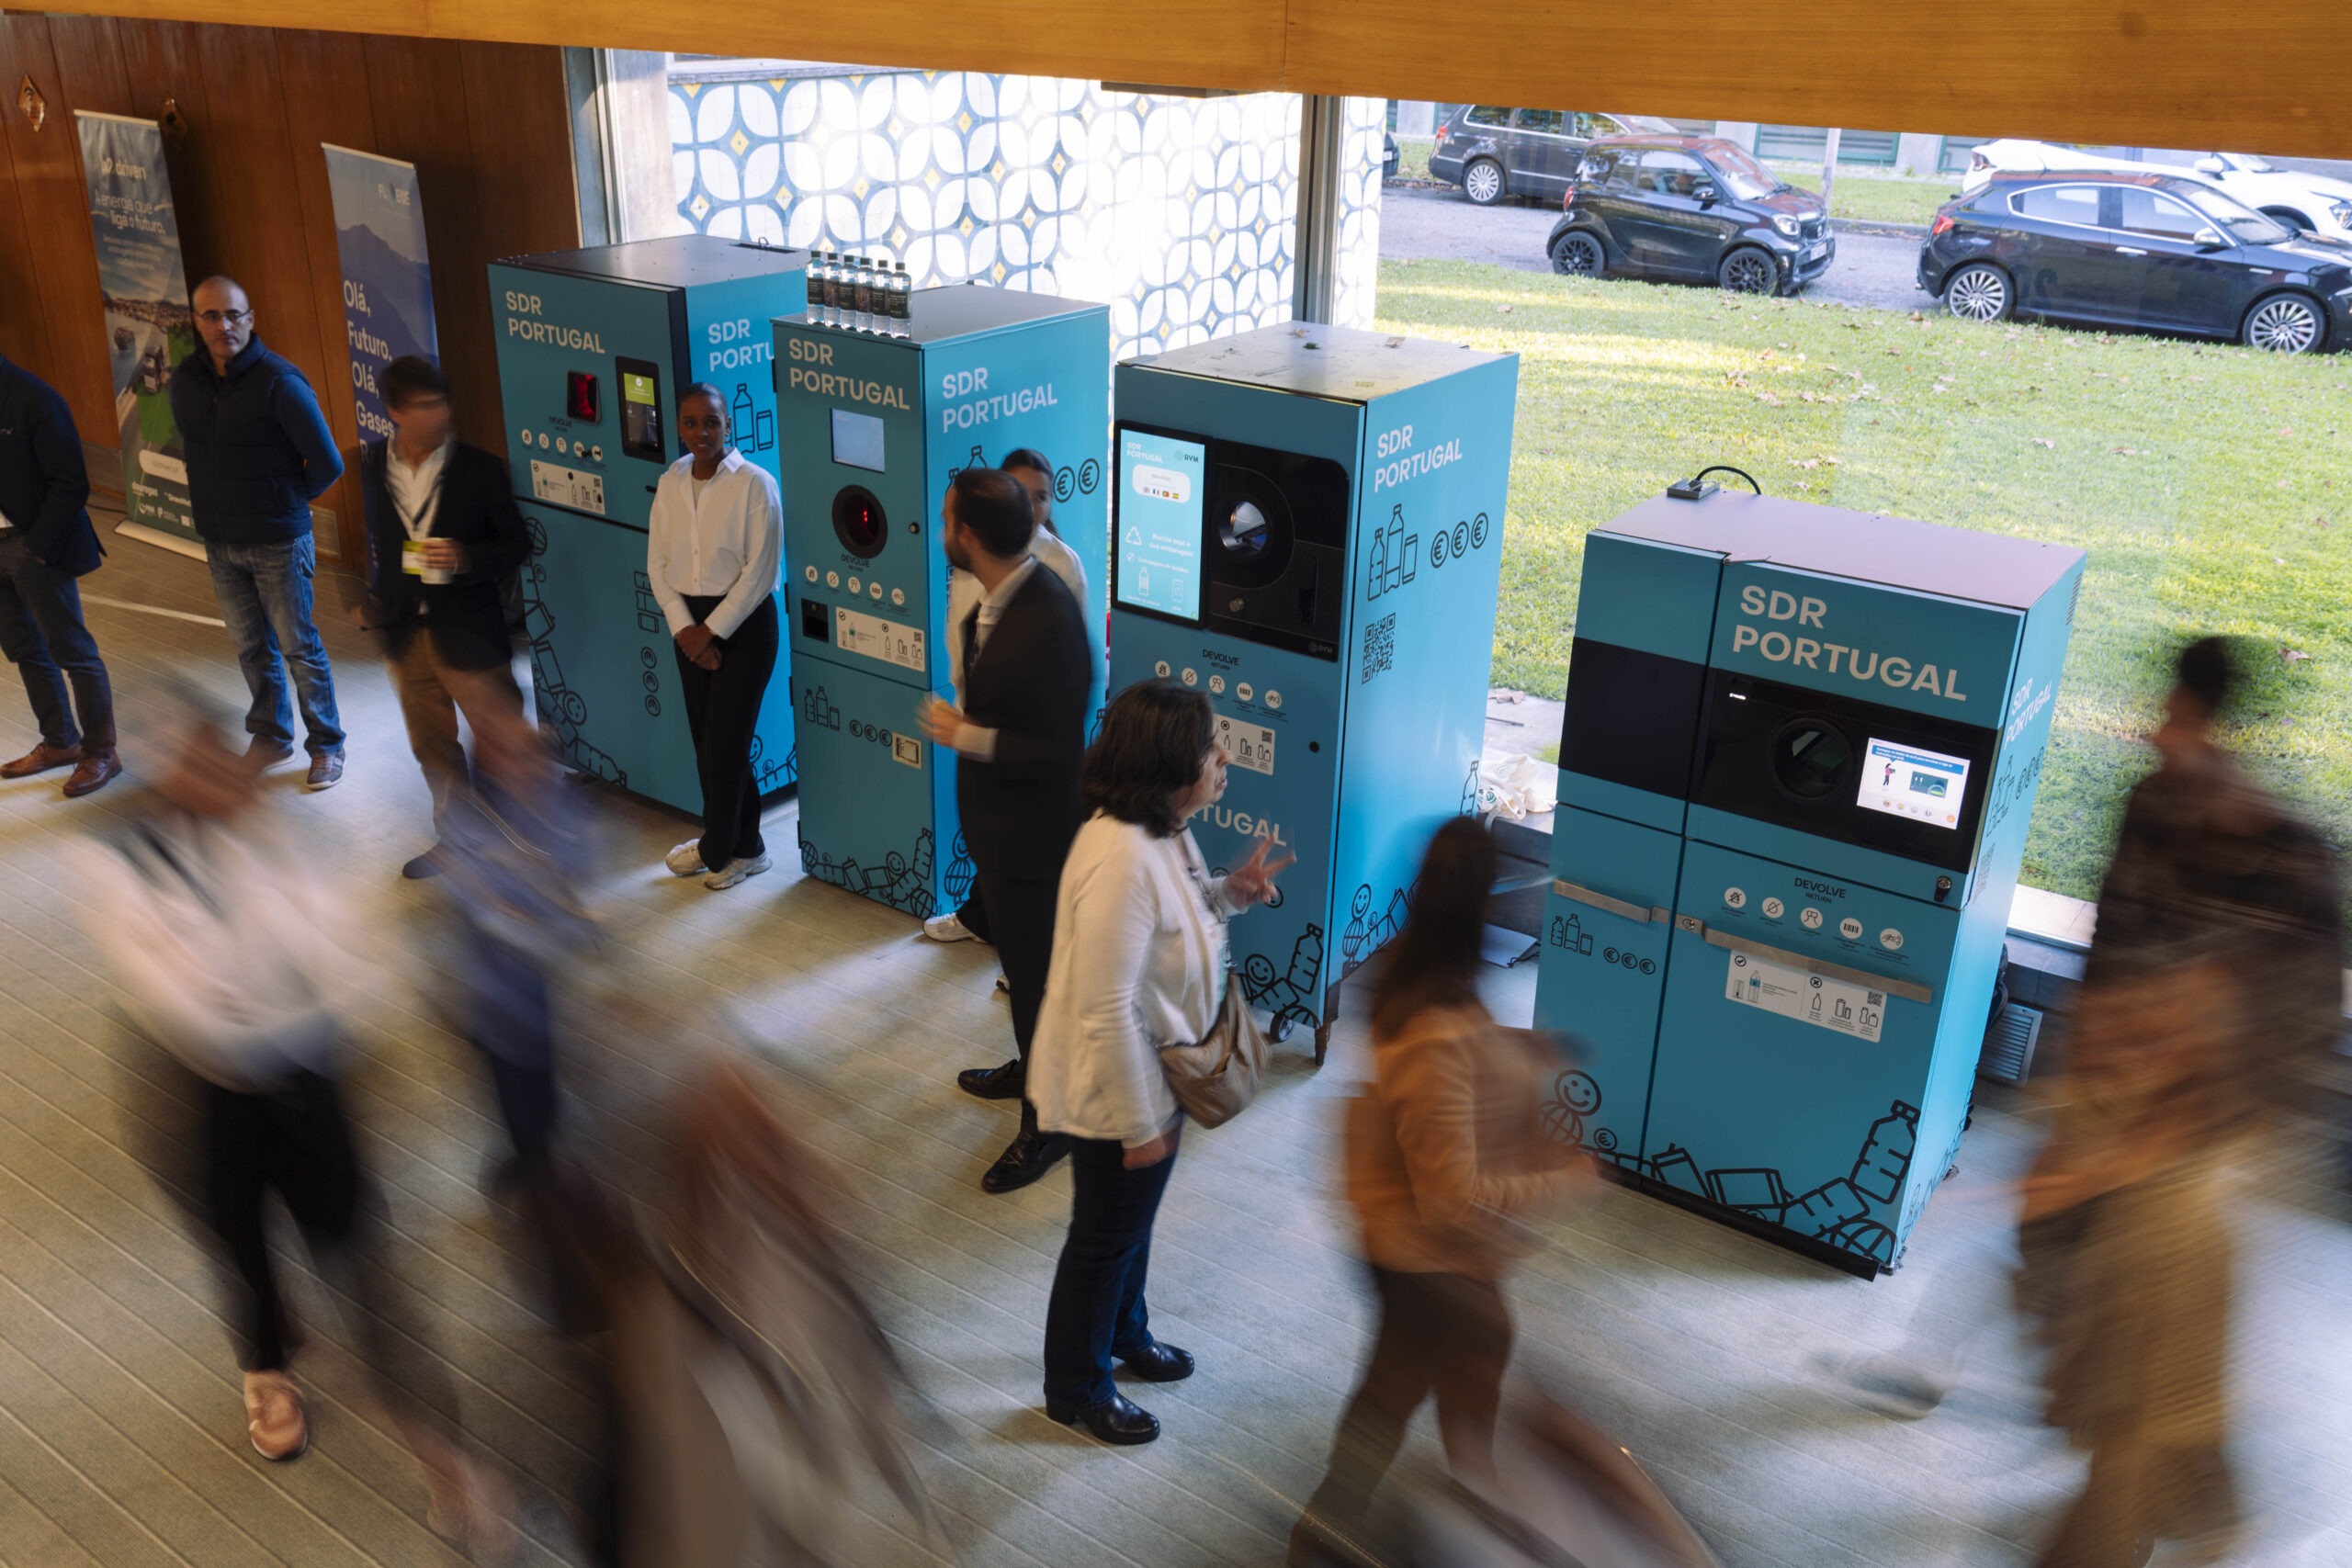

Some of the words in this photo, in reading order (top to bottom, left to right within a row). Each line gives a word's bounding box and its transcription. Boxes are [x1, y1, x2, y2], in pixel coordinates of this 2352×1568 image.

[344, 279, 371, 318] Olá,
[505, 290, 543, 316] SDR
[347, 320, 392, 363] Futuro.
[508, 317, 605, 354] PORTUGAL
[708, 319, 751, 344] SDR
[709, 342, 775, 372] PORTU
[788, 338, 833, 366] SDR
[352, 360, 379, 399] Olá,
[790, 367, 910, 411] PORTUGAL
[943, 367, 988, 399] SDR
[356, 400, 395, 438] Gases
[943, 383, 1057, 434] PORTUGAL
[1126, 441, 1141, 451] SDR
[1126, 449, 1163, 463] PORTUGAL
[1377, 424, 1413, 458] SDR
[1184, 454, 1199, 463] RVM
[1374, 438, 1463, 493] PORTUGAL
[841, 553, 870, 568] DEVOLVE
[1740, 585, 1827, 629] SDR
[1202, 649, 1239, 666] DEVOLVE
[1211, 661, 1230, 671] RETURN
[1733, 625, 1967, 701] PORTUGAL
[2011, 677, 2033, 716] SDR
[2004, 679, 2052, 750] PORTUGAL
[1794, 877, 1847, 899] DEVOLVE
[1805, 892, 1832, 904] RETURN
